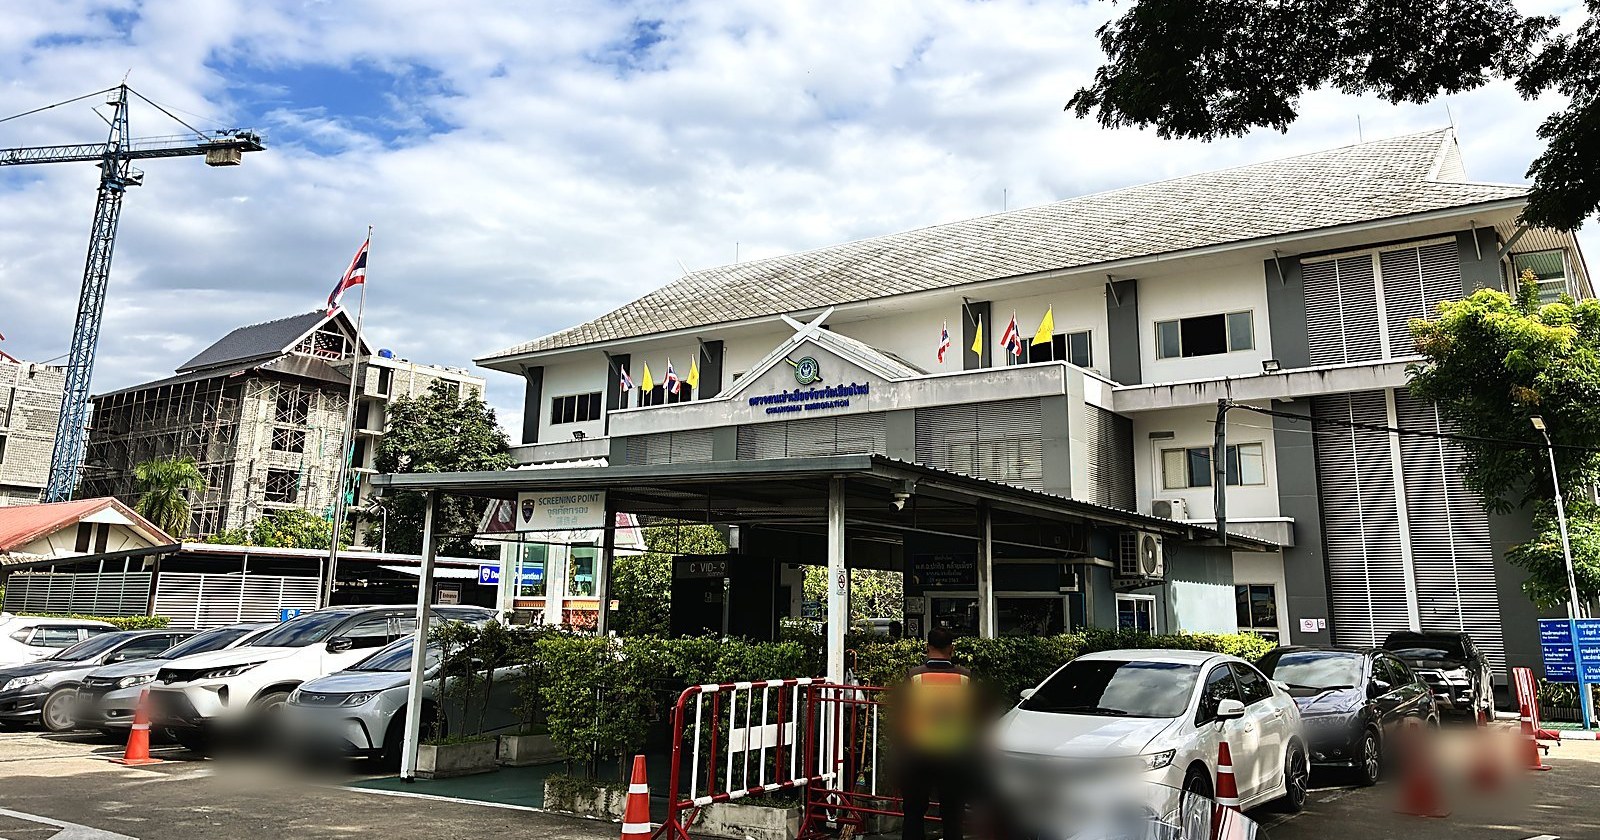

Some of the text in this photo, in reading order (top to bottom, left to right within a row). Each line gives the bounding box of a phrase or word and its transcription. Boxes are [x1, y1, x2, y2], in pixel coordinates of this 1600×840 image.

[804, 399, 849, 410] IMMIGRATION
[538, 493, 600, 506] SCREENING POINT
